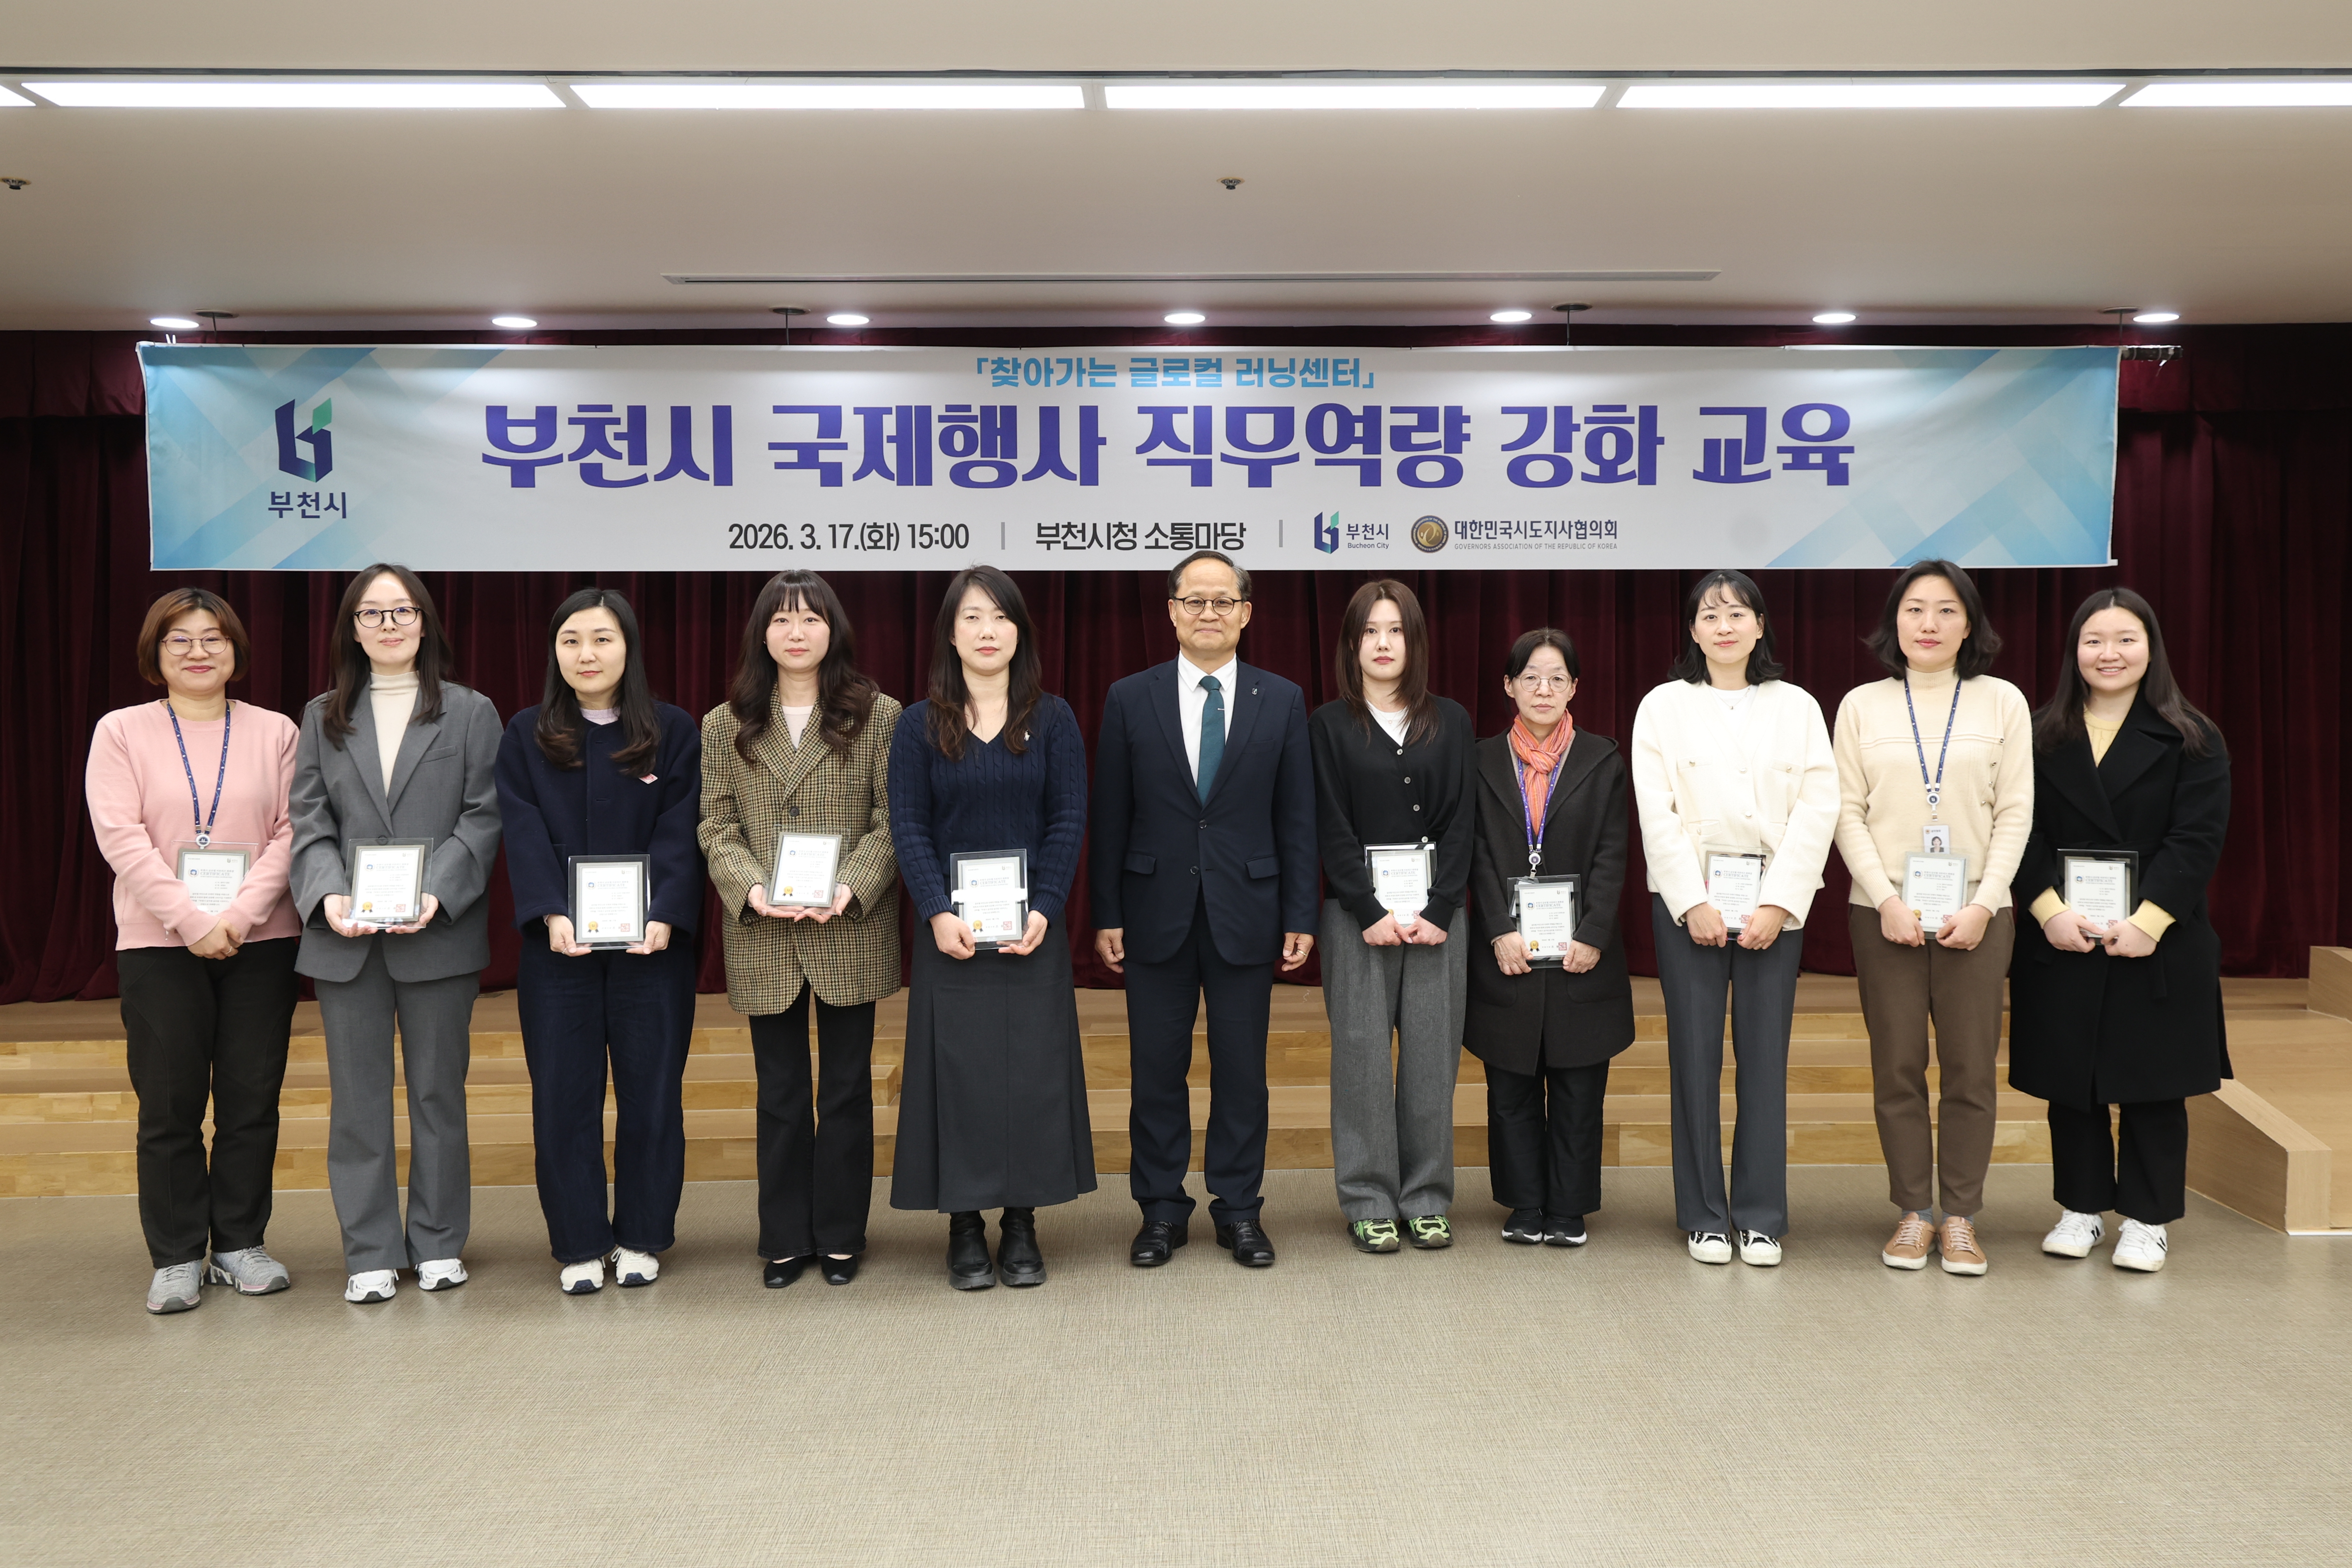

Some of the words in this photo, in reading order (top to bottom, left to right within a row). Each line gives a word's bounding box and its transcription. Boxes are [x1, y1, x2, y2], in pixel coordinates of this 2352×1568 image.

[977, 357, 1117, 388] 「찾아가는
[1129, 358, 1223, 387] 글로컬
[1236, 358, 1374, 388] 러닝센터」
[482, 404, 733, 488] 부천시
[768, 404, 1107, 489] 국제행사
[1136, 403, 1471, 489] 직무역량
[1501, 404, 1665, 488] 강화
[1693, 403, 1855, 486] 교육
[268, 491, 346, 519] 부천시
[728, 523, 794, 550] 2026.
[800, 523, 821, 550] 3.
[907, 523, 969, 549] 15:00
[1036, 521, 1137, 551] 부천시청
[1144, 522, 1247, 551] 소통마당
[1346, 523, 1388, 540] 부천시
[1455, 519, 1617, 540] 대한민국시도지사협의회
